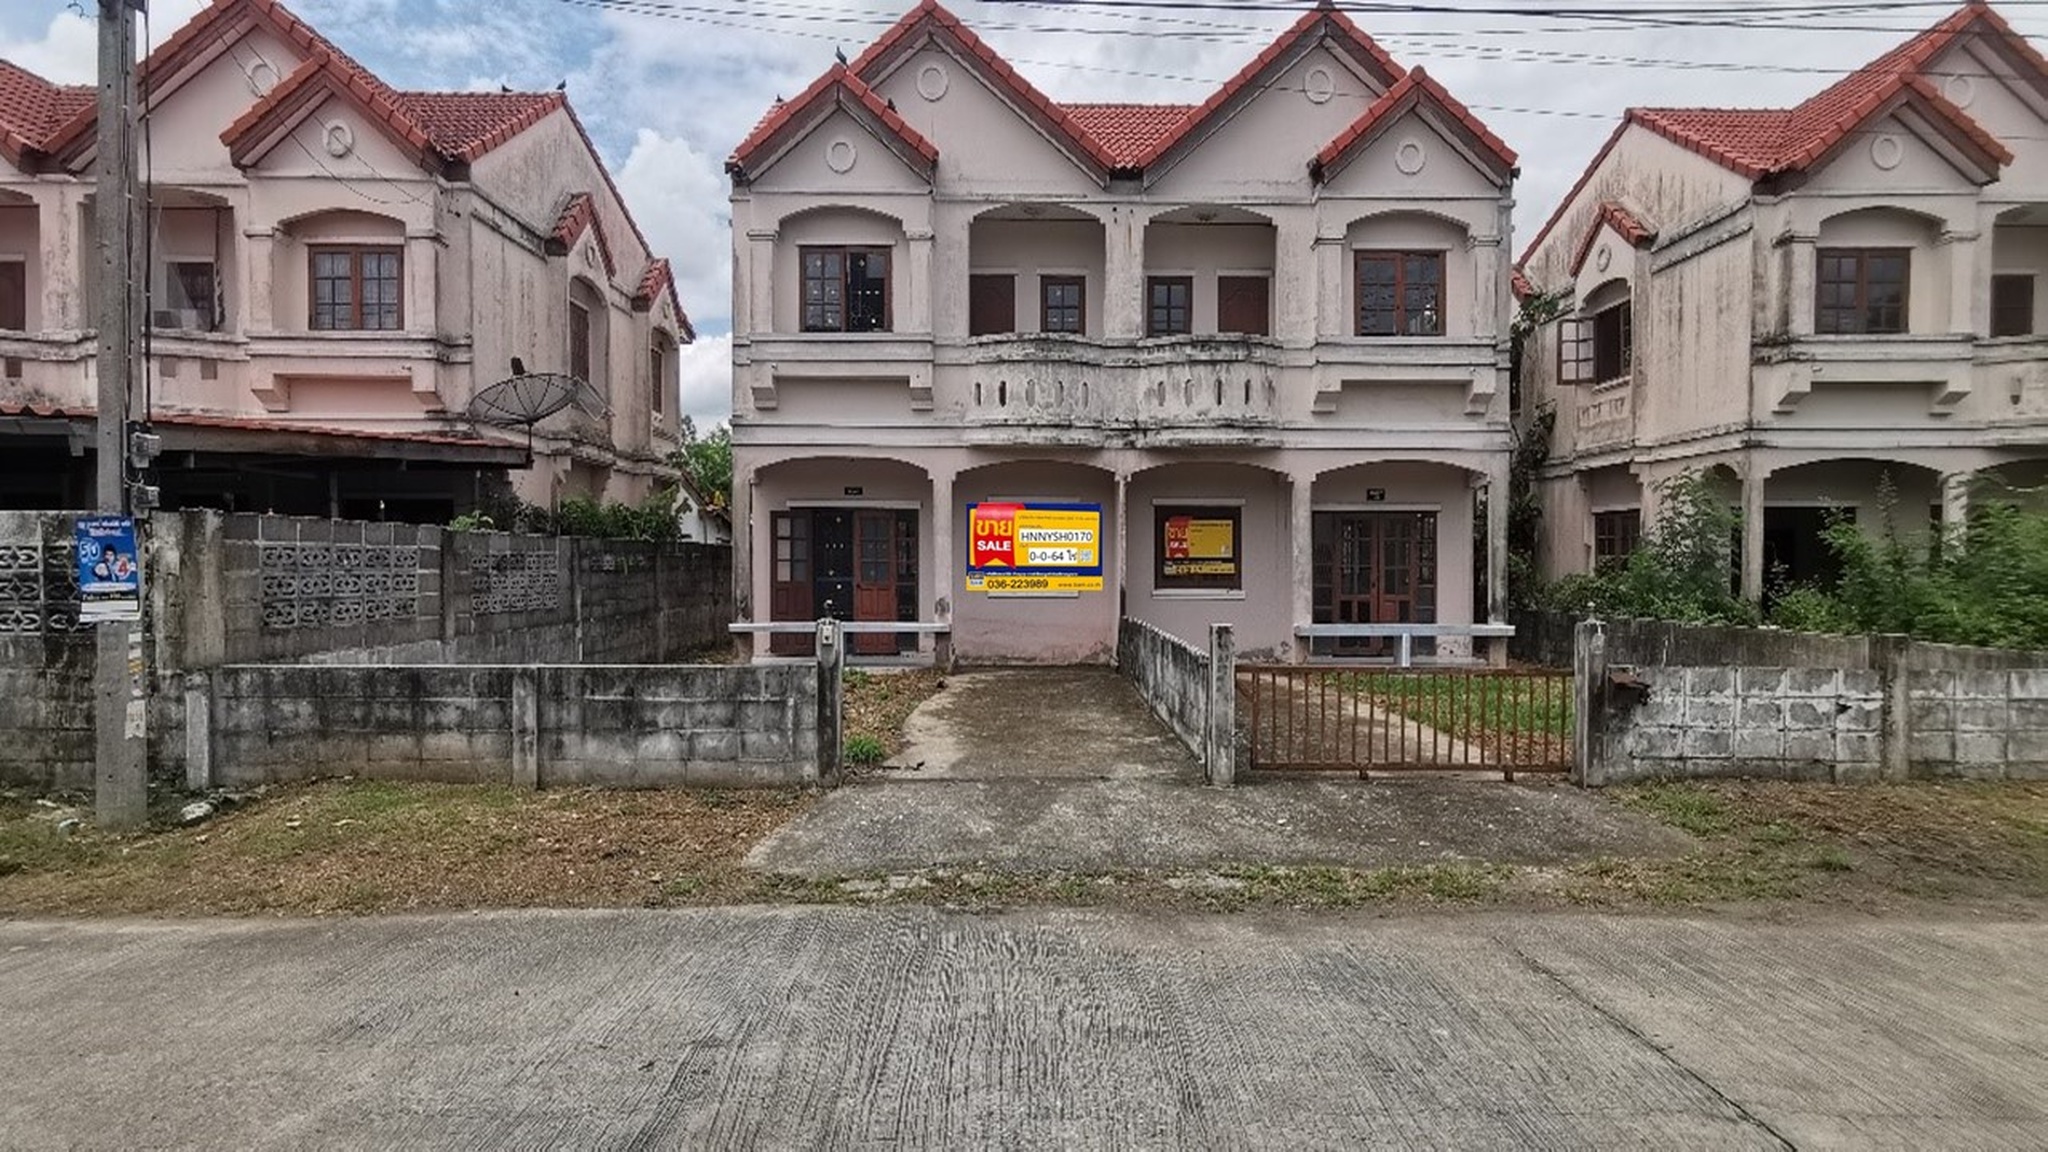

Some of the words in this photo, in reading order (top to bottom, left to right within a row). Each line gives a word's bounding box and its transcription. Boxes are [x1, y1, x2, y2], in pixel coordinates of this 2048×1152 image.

[976, 519, 1012, 536] ขาย
[1021, 531, 1093, 541] HNNYSH0170
[977, 540, 1012, 551] SALE
[1029, 551, 1064, 561] 0-0-64
[986, 579, 1049, 589] 036-223989
